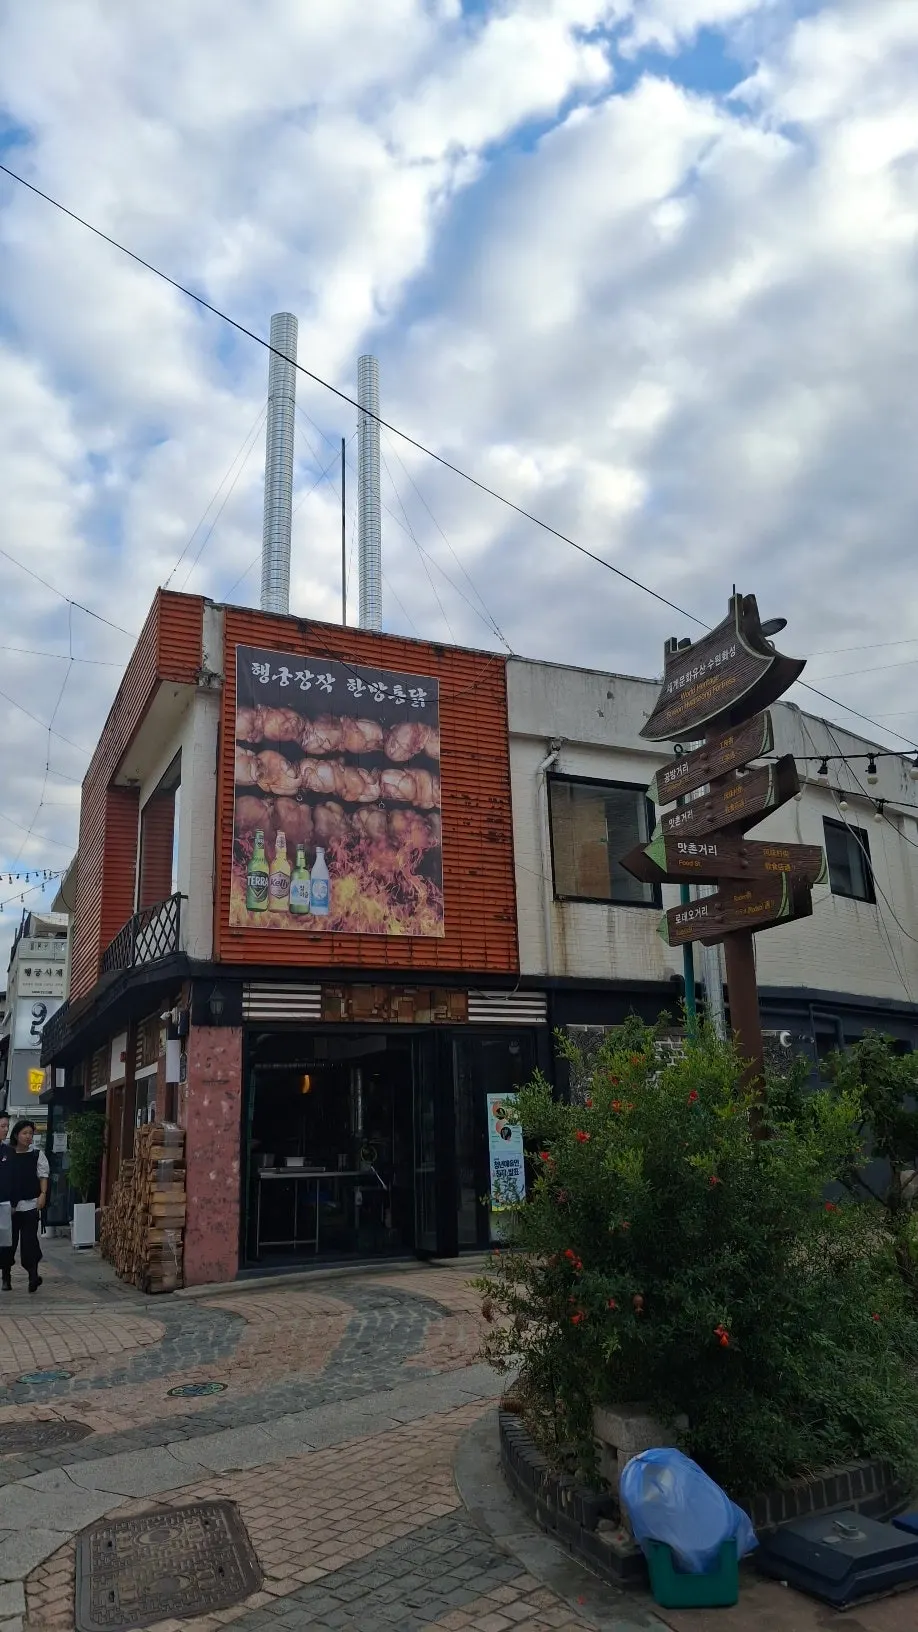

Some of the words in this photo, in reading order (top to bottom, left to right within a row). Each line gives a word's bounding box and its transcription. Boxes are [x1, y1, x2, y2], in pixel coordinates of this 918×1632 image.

[666, 663, 706, 694] 세계문화유산
[707, 644, 736, 670] 수원화성
[251, 662, 336, 694] 행궁장작
[346, 678, 427, 708] 한방통닭
[712, 676, 737, 695] Fortress
[680, 688, 696, 701] World
[663, 762, 689, 784] 공방거리
[677, 842, 718, 856] 맛촌거리
[678, 859, 694, 868] Food
[247, 876, 269, 886] TERRA
[270, 879, 288, 889] Kelly
[675, 906, 709, 925] 로데오거리
